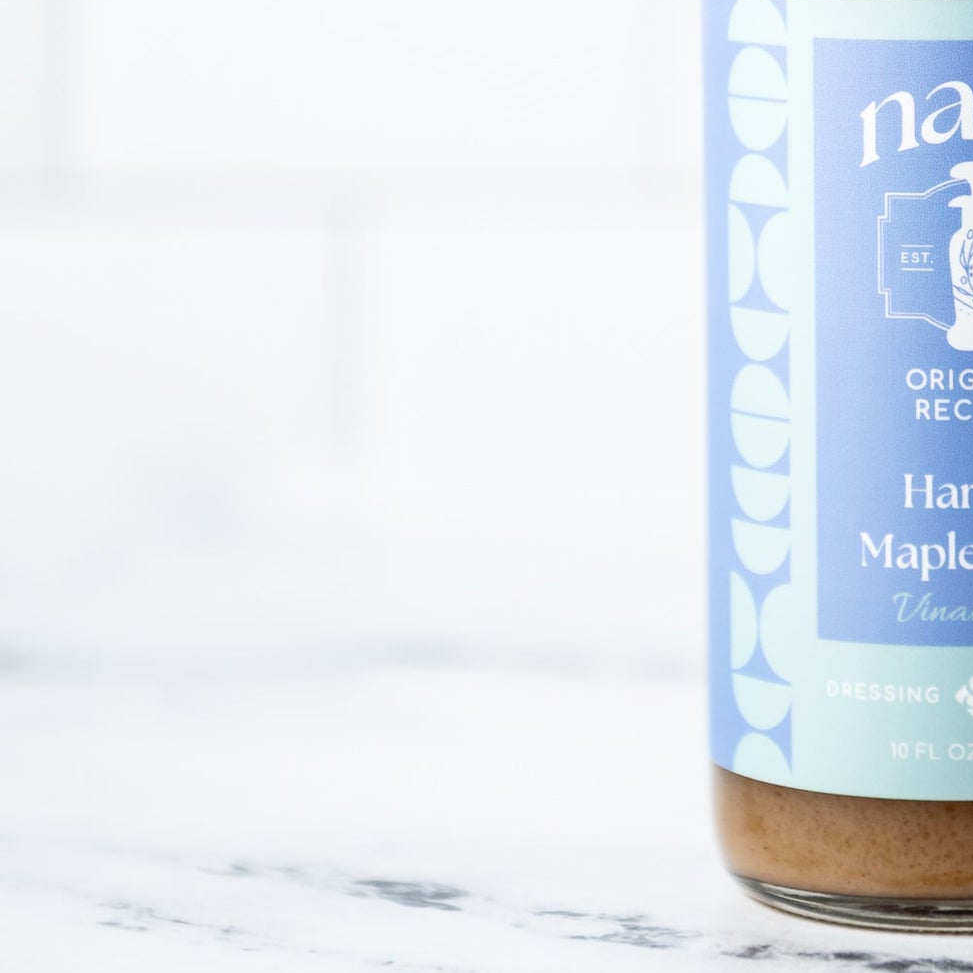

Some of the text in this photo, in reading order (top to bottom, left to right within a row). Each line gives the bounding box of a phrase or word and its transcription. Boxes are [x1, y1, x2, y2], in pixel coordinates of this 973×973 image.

[900, 251, 935, 264] EST.
[826, 679, 941, 705] DRESSING
[890, 742, 908, 760] 10
[916, 742, 940, 761] FL
